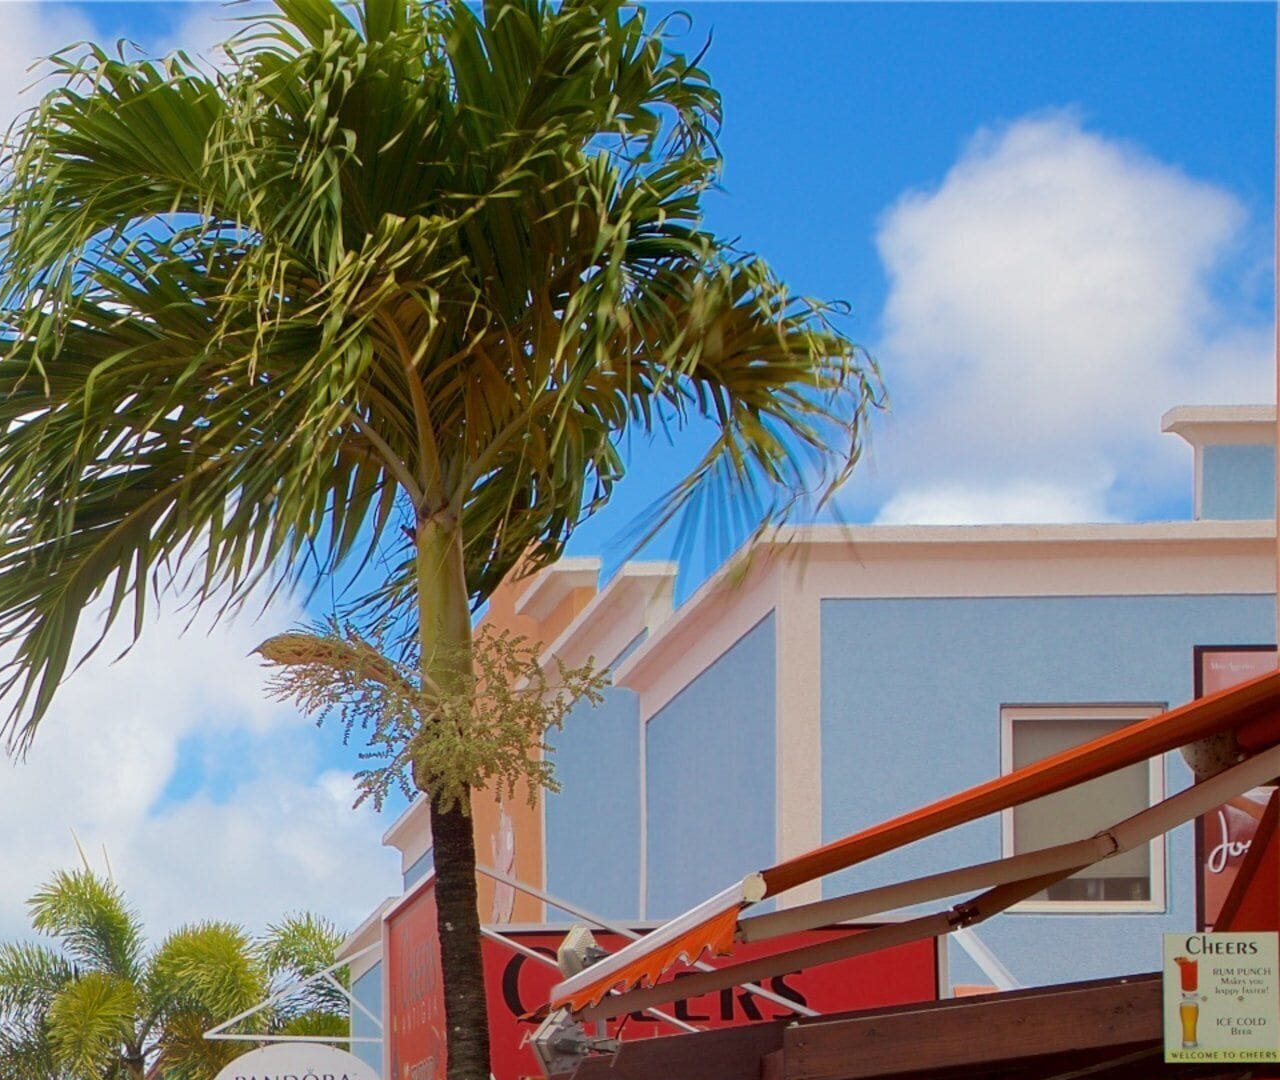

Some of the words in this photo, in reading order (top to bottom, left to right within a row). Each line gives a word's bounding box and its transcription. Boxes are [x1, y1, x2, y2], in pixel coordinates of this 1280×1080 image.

[1212, 967, 1235, 976] RUM
[1236, 967, 1272, 976] PUNCH
[1216, 1017, 1233, 1027] ICE
[1236, 1017, 1267, 1026] COLD
[1171, 1051, 1218, 1060] WELCOME
[1223, 1051, 1236, 1060] TO
[1239, 1051, 1277, 1060] CHEERS
